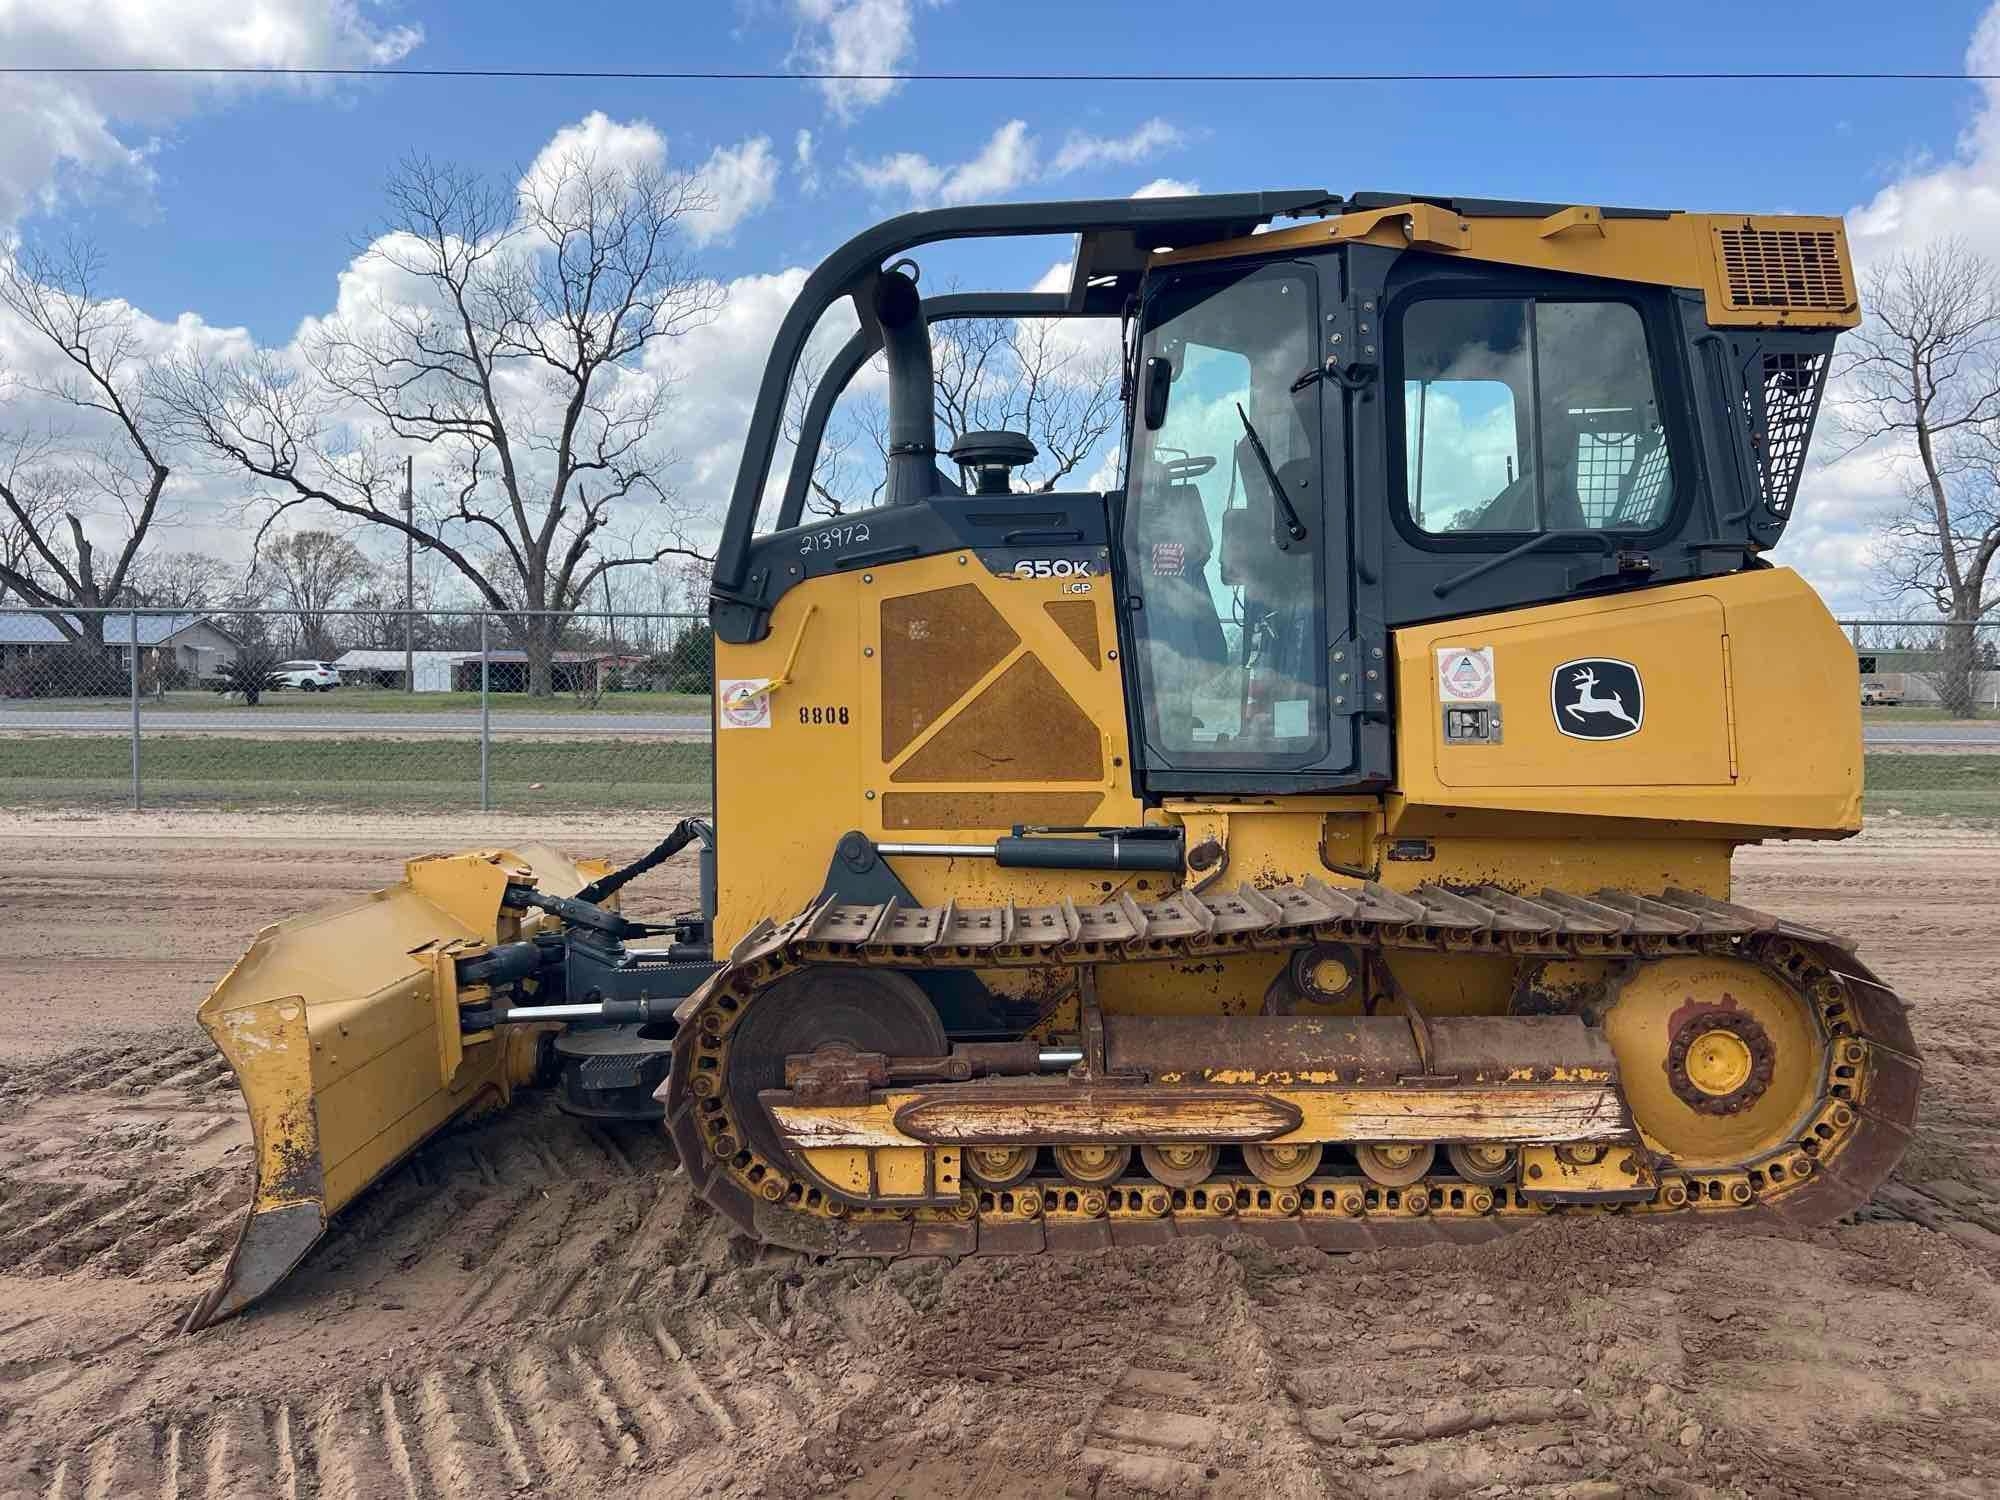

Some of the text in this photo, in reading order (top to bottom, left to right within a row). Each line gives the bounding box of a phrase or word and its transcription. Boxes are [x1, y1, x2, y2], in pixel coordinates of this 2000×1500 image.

[800, 523, 870, 555] 213972
[1014, 559, 1090, 578] 650K
[1063, 583, 1092, 594] LGP
[799, 706, 849, 725] 8808
